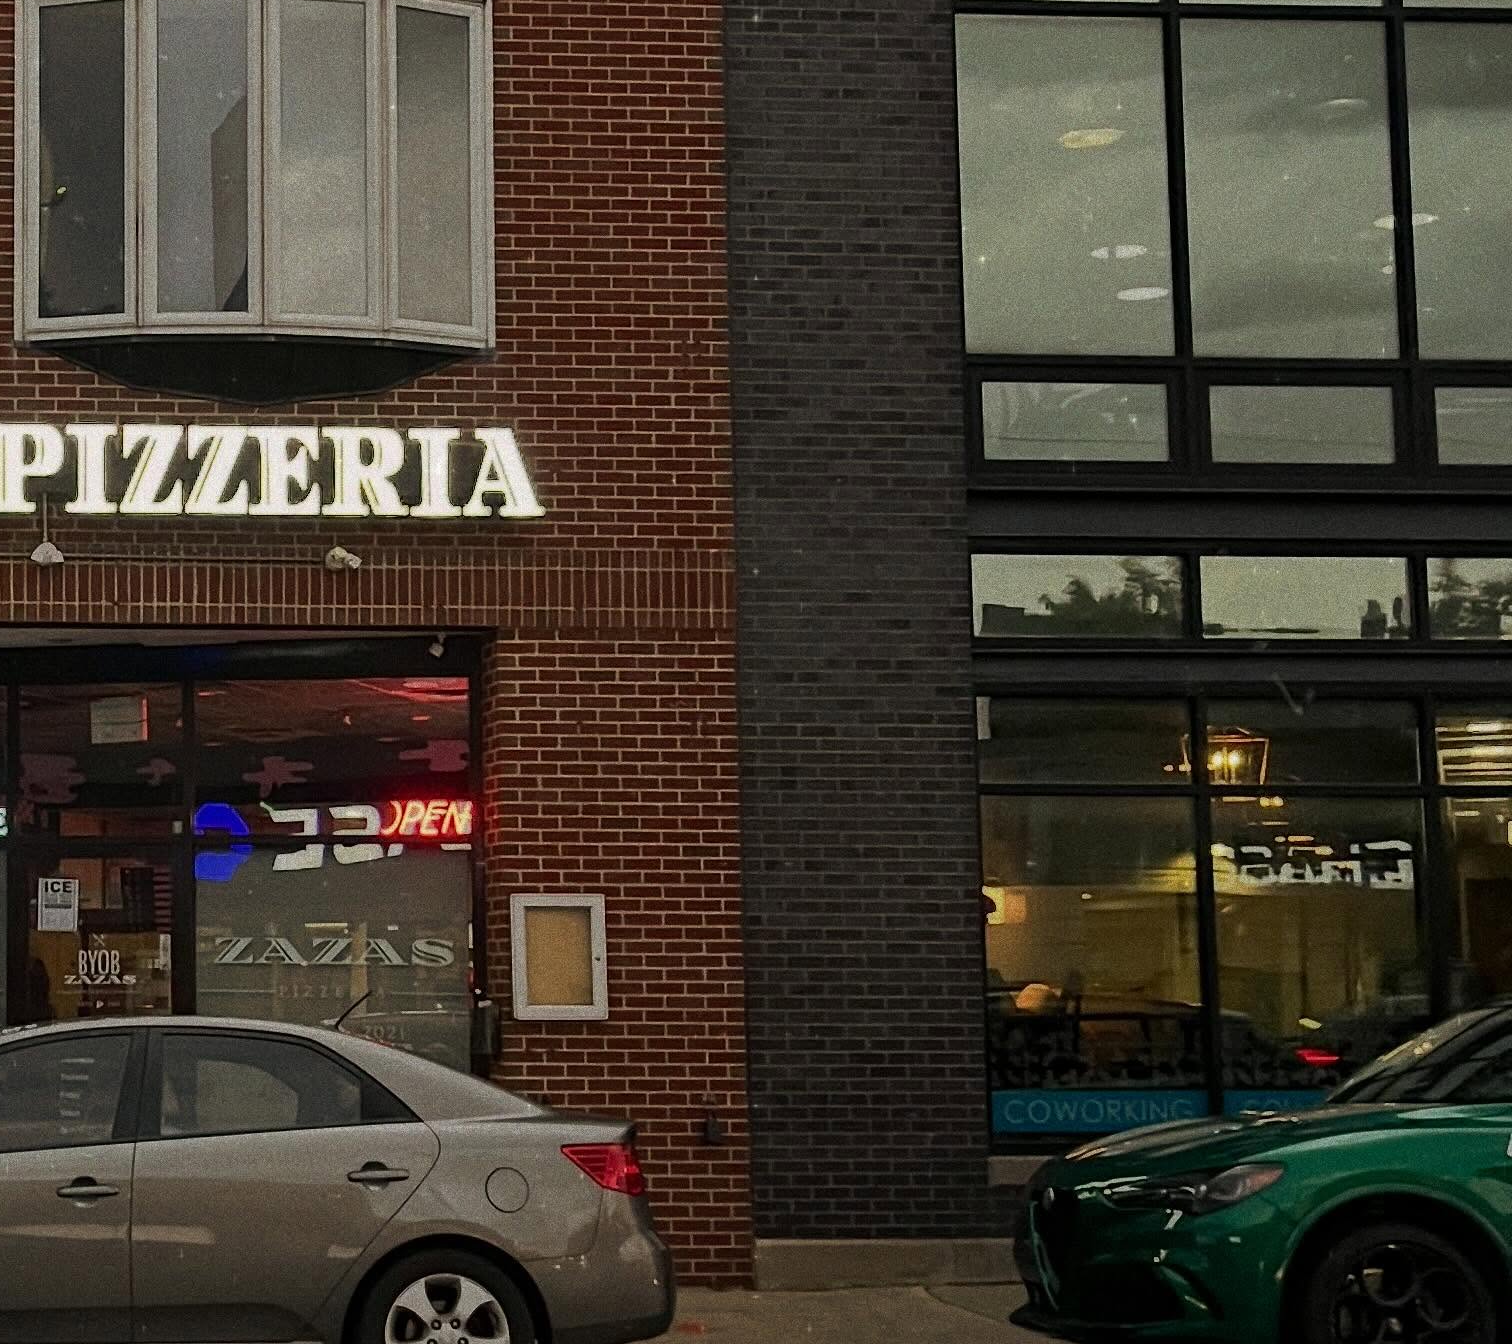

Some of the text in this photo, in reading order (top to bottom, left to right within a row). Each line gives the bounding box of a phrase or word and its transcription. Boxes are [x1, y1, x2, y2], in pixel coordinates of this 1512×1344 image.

[44, 880, 73, 894] ICE
[214, 937, 455, 967] ZAZAS
[78, 949, 121, 976] BYOB
[64, 975, 137, 985] ZAZAS
[279, 985, 385, 999] PIZZEA
[1004, 1098, 1193, 1125] COWORKING
